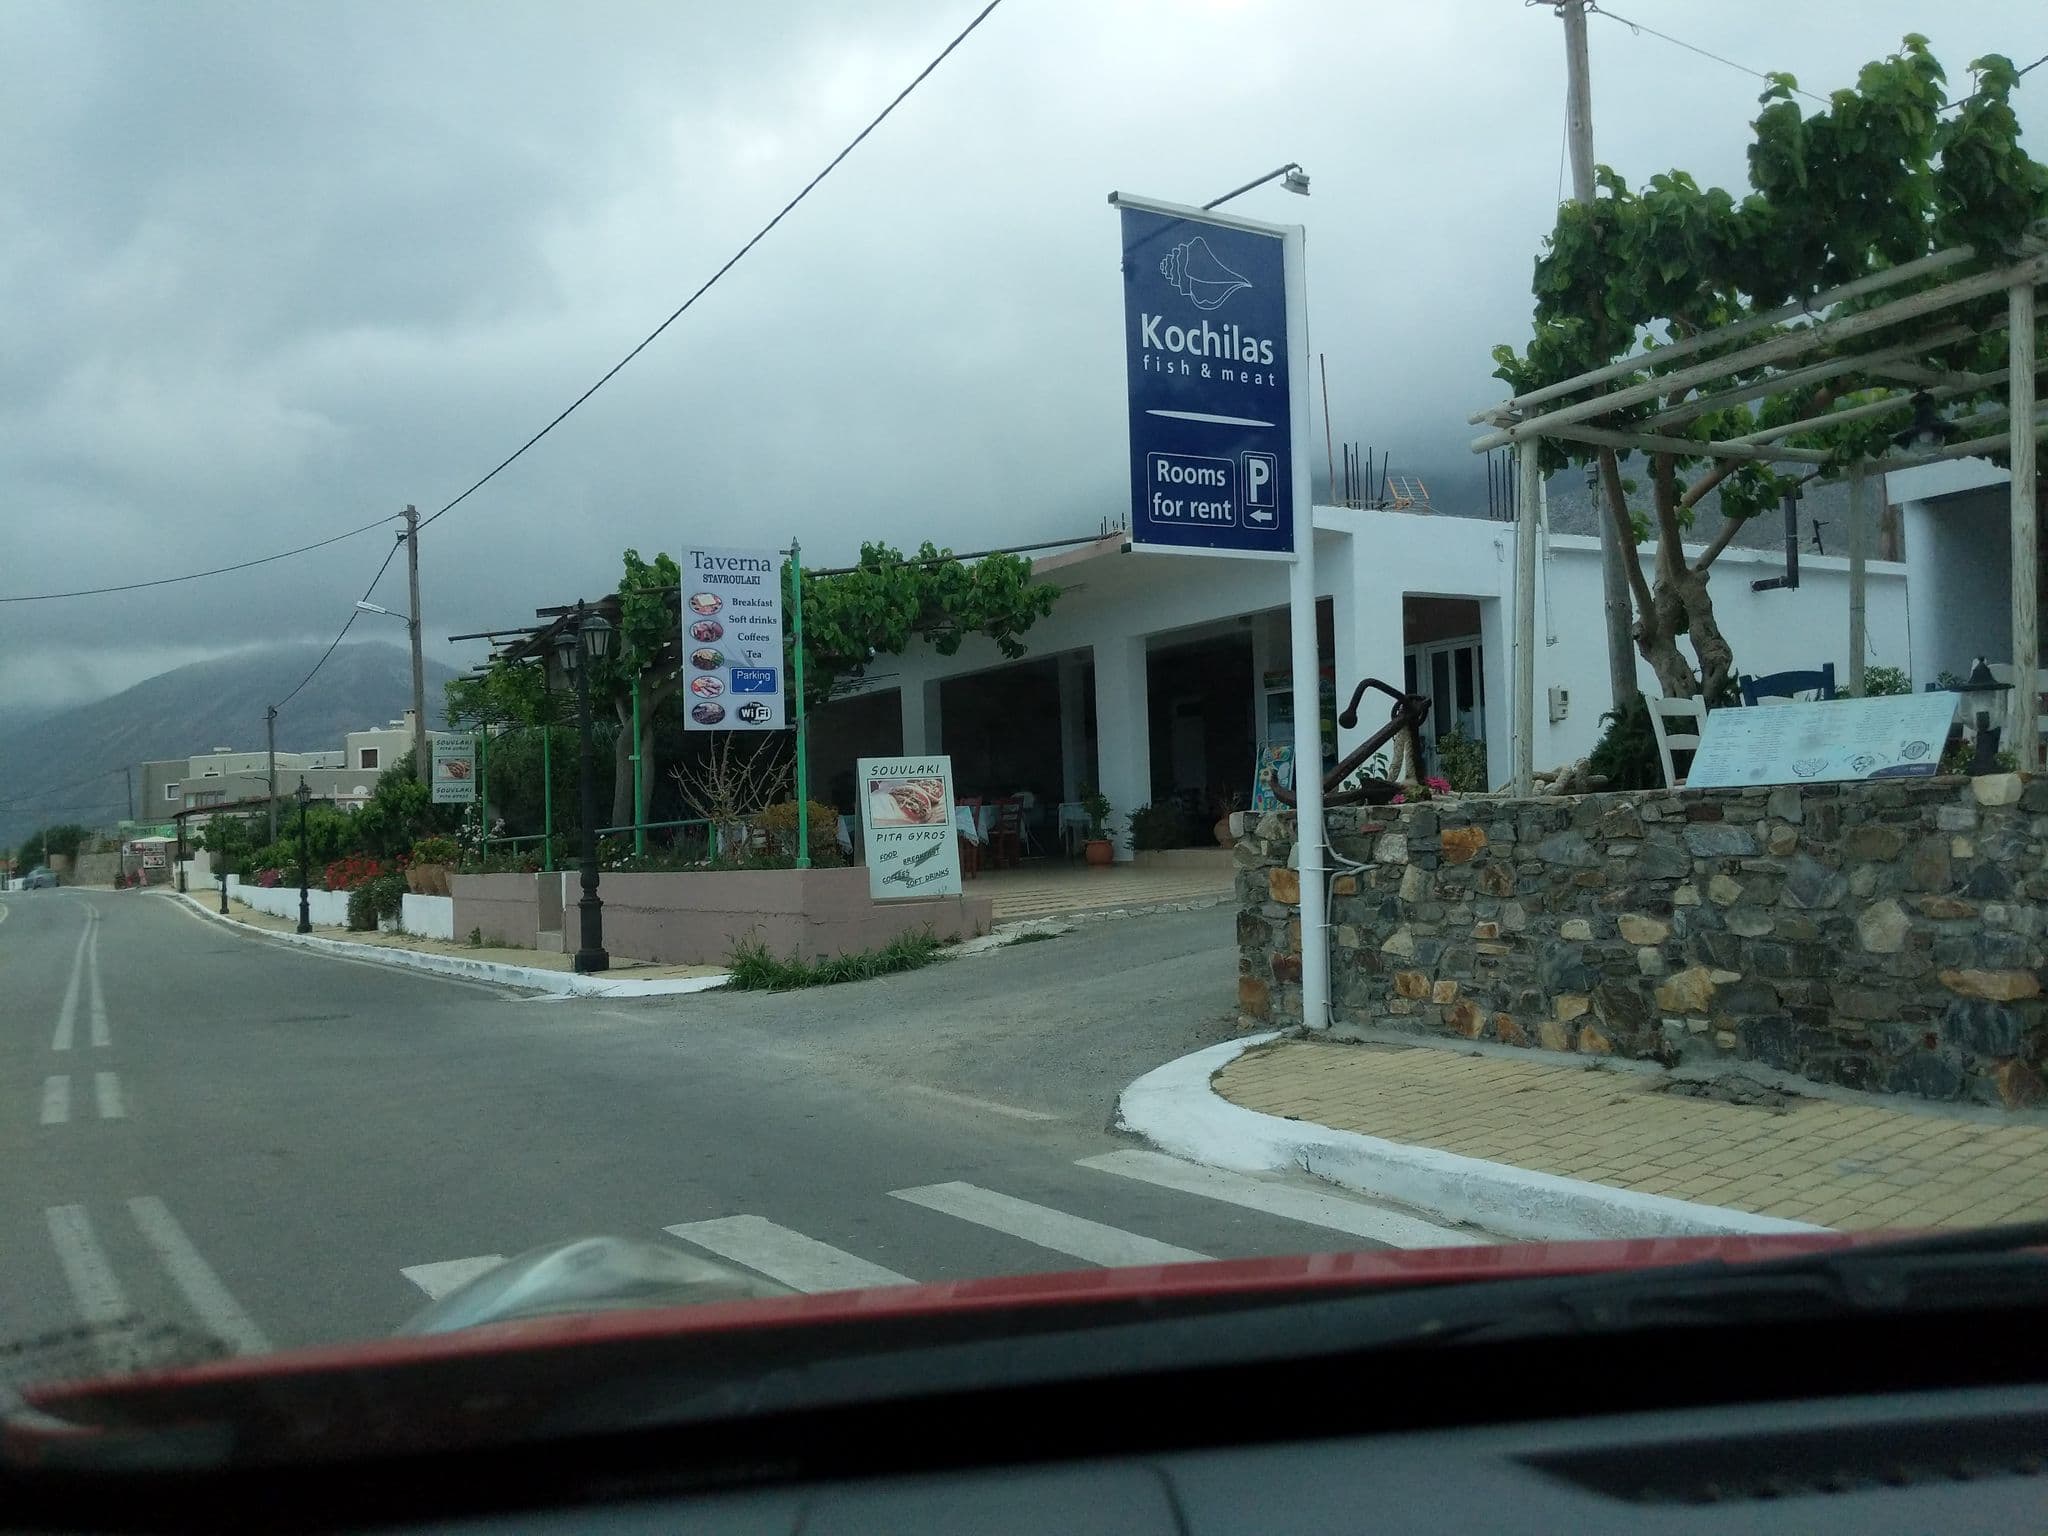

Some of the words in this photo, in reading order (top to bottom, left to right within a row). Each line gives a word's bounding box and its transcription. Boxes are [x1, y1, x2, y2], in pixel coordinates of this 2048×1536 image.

[1141, 313, 1274, 365] Kochilas
[1143, 355, 1190, 376] fish
[1201, 362, 1212, 379] &
[1221, 369, 1275, 387] meat
[1157, 459, 1226, 487] Rooms
[1249, 458, 1270, 503] P
[1153, 493, 1183, 518] for
[1190, 498, 1232, 521] rent
[690, 551, 772, 572] Taverna
[702, 574, 761, 585] STAVROULAKI
[732, 598, 773, 607] Breakfast
[729, 615, 747, 624] Soft
[749, 615, 777, 625] drinks
[737, 632, 770, 642] Coffees
[747, 650, 762, 659] Tea
[736, 671, 771, 682] Parking
[871, 764, 940, 776] SOUVLAKI
[876, 833, 902, 842] PITA
[908, 831, 946, 841] GYROS
[880, 850, 898, 861] FOOD
[902, 848, 940, 865] BREAKFAST
[905, 876, 923, 889] SOFT
[925, 867, 950, 883] DRINKS
